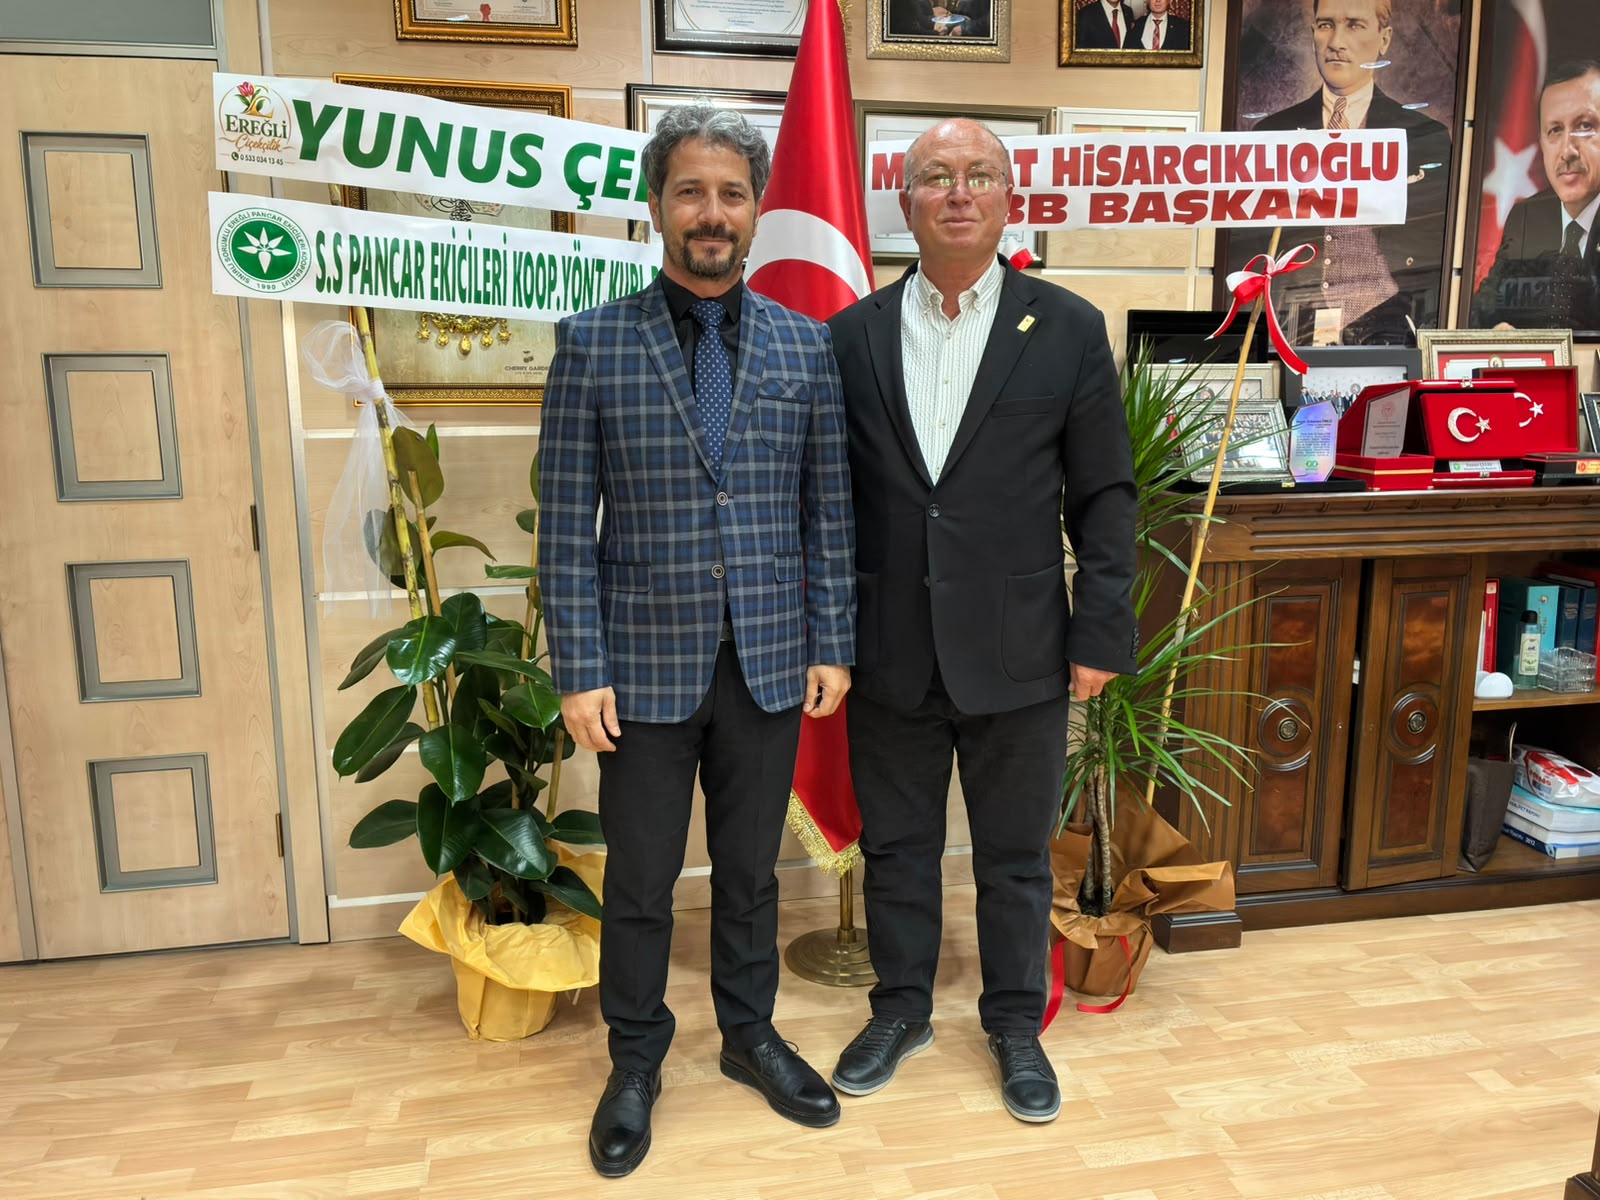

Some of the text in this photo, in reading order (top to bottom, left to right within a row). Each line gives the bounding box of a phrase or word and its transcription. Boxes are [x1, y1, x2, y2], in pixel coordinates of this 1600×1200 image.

[225, 114, 287, 139] EREĞLİ
[235, 134, 282, 153] Çiçekçilik
[292, 99, 545, 189] YUNUS
[245, 154, 256, 162] 533
[256, 156, 268, 164] 034
[268, 157, 275, 165] 13
[276, 157, 284, 165] 45
[1088, 187, 1358, 226] BAŞKANI
[219, 211, 308, 288] SINIRLI SORUMLU EREĞLİ PANCAR EKİCİLERİ KOOPERATİFİ
[315, 229, 343, 294] S.S
[348, 235, 425, 299] PANCAR
[430, 227, 508, 306] EKİCİLERİ
